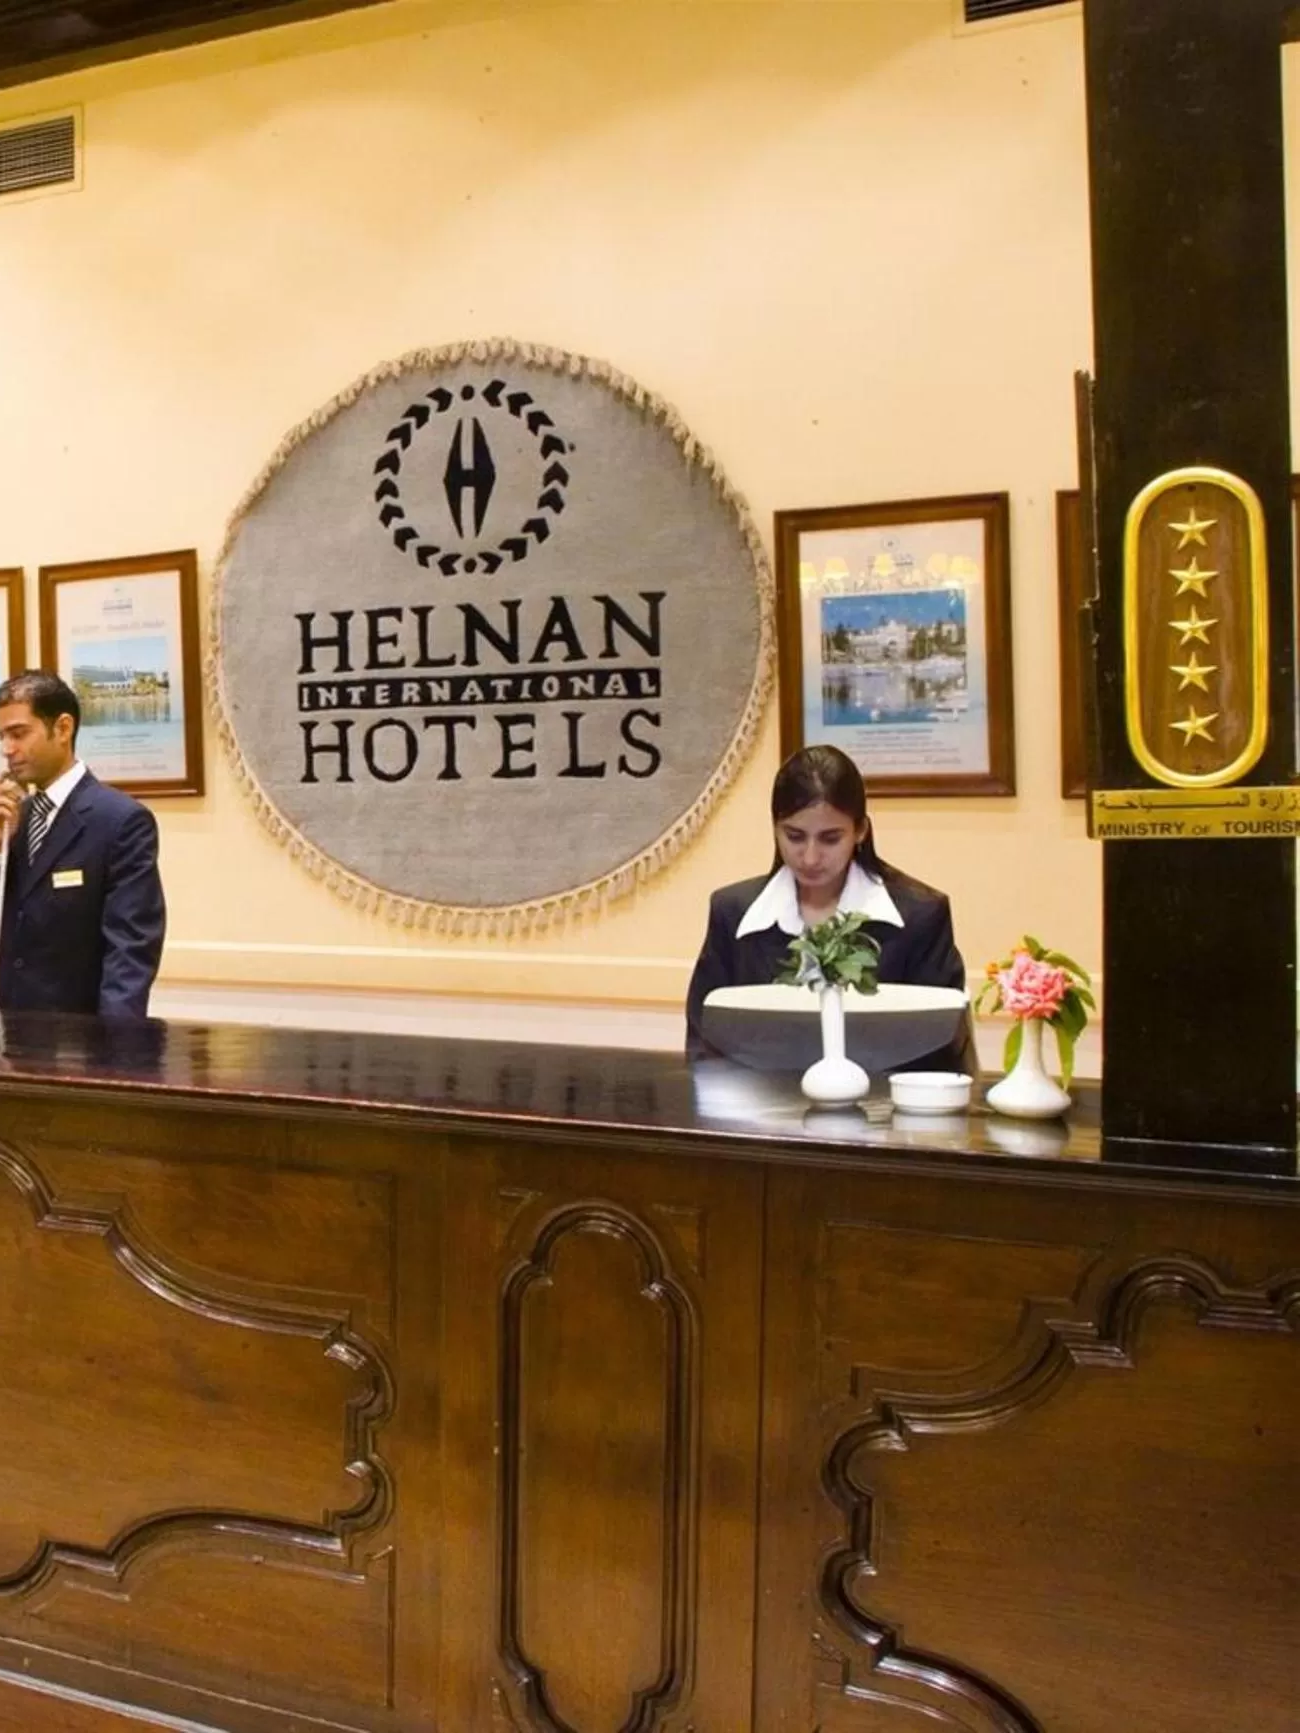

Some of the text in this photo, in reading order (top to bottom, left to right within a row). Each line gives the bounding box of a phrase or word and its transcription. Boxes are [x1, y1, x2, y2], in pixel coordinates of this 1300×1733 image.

[294, 591, 667, 674] HELNAN
[301, 672, 657, 708] INTERNATIONAL
[299, 708, 662, 782] HOTELS
[1258, 792, 1300, 812] زارة
[1097, 821, 1185, 836] MINISTRY
